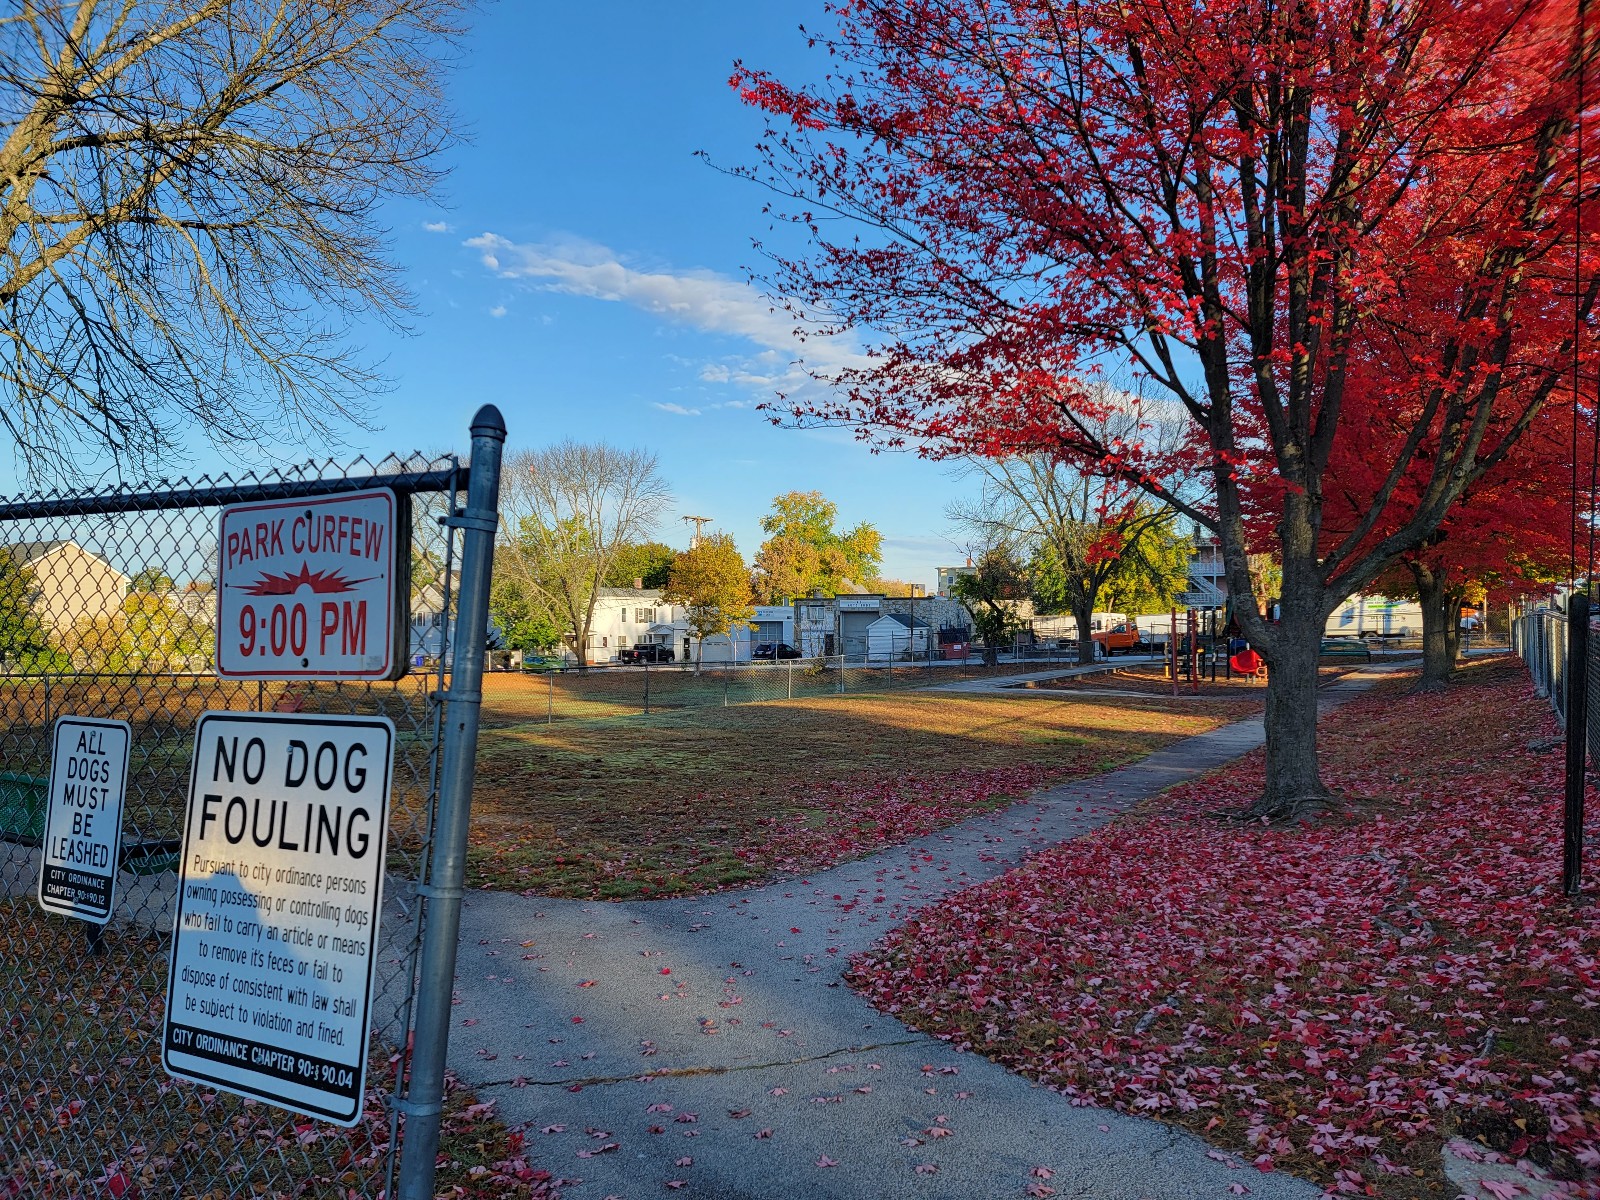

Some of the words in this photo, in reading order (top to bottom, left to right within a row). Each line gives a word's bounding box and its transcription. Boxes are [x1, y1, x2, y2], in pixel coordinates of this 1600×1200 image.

[228, 519, 285, 570] PARK
[292, 515, 383, 561] CURFEW
[240, 603, 307, 657] 9:00
[320, 601, 366, 655] PM
[76, 731, 105, 755] ALL
[213, 736, 265, 785] NO
[285, 740, 367, 793] DOG
[68, 757, 109, 783] DOGS
[63, 783, 109, 811] MUST
[72, 812, 93, 837] BE
[199, 794, 370, 859] FOULING
[52, 836, 108, 868] LEASHED
[47, 884, 75, 897] CHAPTER
[51, 870, 66, 880] CITY
[69, 873, 104, 889] ORDINANCE
[193, 855, 235, 877] Pursuant
[239, 862, 248, 878] to
[253, 862, 271, 886] city
[275, 866, 322, 888] ordinance
[326, 875, 366, 895] persons
[187, 883, 217, 907] owning
[220, 889, 271, 916] possessing
[275, 897, 286, 912] or
[290, 899, 341, 927] controlling
[345, 905, 368, 931] dogs
[184, 910, 201, 927] who
[205, 914, 221, 931] fail
[224, 917, 232, 933] to
[237, 920, 263, 941] carry
[267, 925, 278, 941] an
[282, 926, 313, 947] article
[317, 934, 328, 949] or
[332, 937, 365, 957] means
[200, 940, 207, 958] to
[212, 944, 246, 964] remove
[250, 948, 264, 967] it's
[267, 951, 293, 973] feces
[298, 959, 309, 976] or
[313, 960, 328, 981] fail
[333, 965, 342, 983] to
[182, 965, 216, 988] dispose
[220, 972, 229, 989] of
[233, 977, 283, 1001] consistent
[287, 986, 307, 1007] with
[311, 991, 328, 1012] law
[333, 997, 356, 1018] shall
[185, 993, 196, 1012] be
[200, 999, 234, 1020] subject
[239, 1006, 248, 1022] to
[252, 1008, 292, 1032] violation
[296, 1020, 313, 1038] and
[317, 1022, 344, 1047] fined.
[173, 1028, 192, 1046] CITY
[196, 1034, 248, 1061] ORDINANCE
[252, 1047, 294, 1073] CHAPTER
